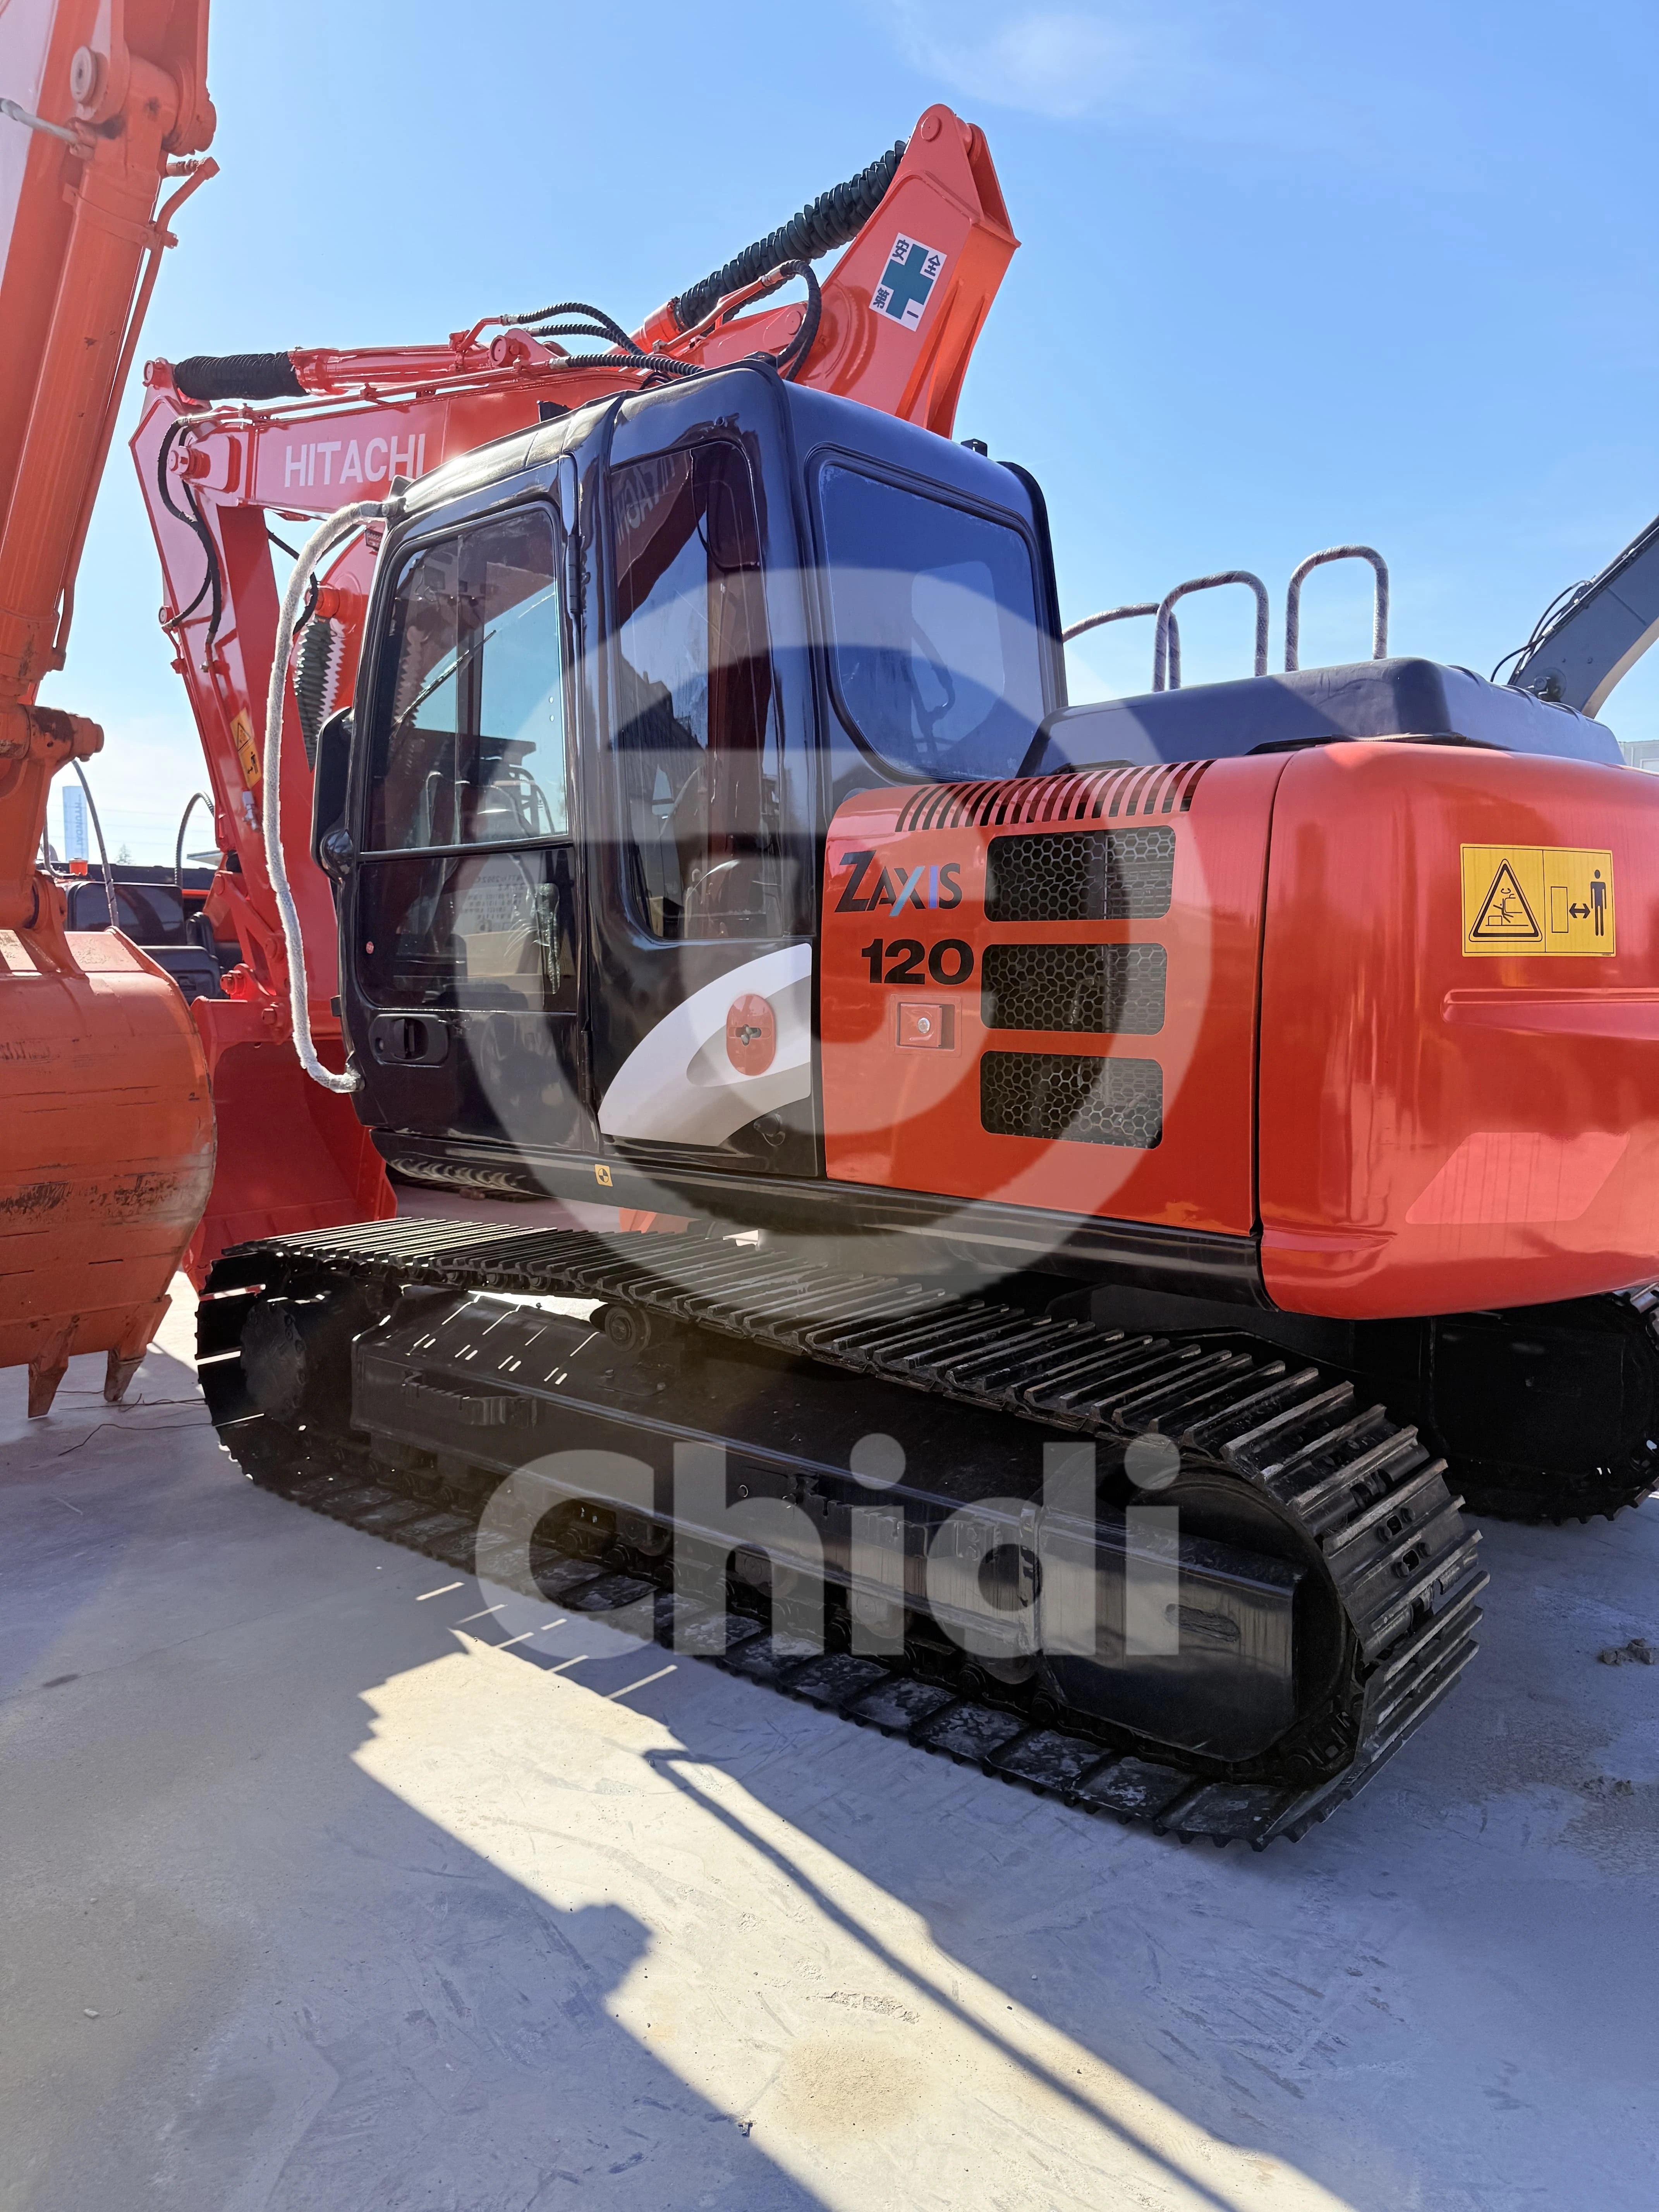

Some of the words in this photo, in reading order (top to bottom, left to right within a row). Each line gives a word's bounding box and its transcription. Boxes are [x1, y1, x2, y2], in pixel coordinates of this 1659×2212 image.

[284, 433, 426, 487] HITACHI
[834, 850, 963, 917] ZAXIS
[861, 938, 974, 985] 120
